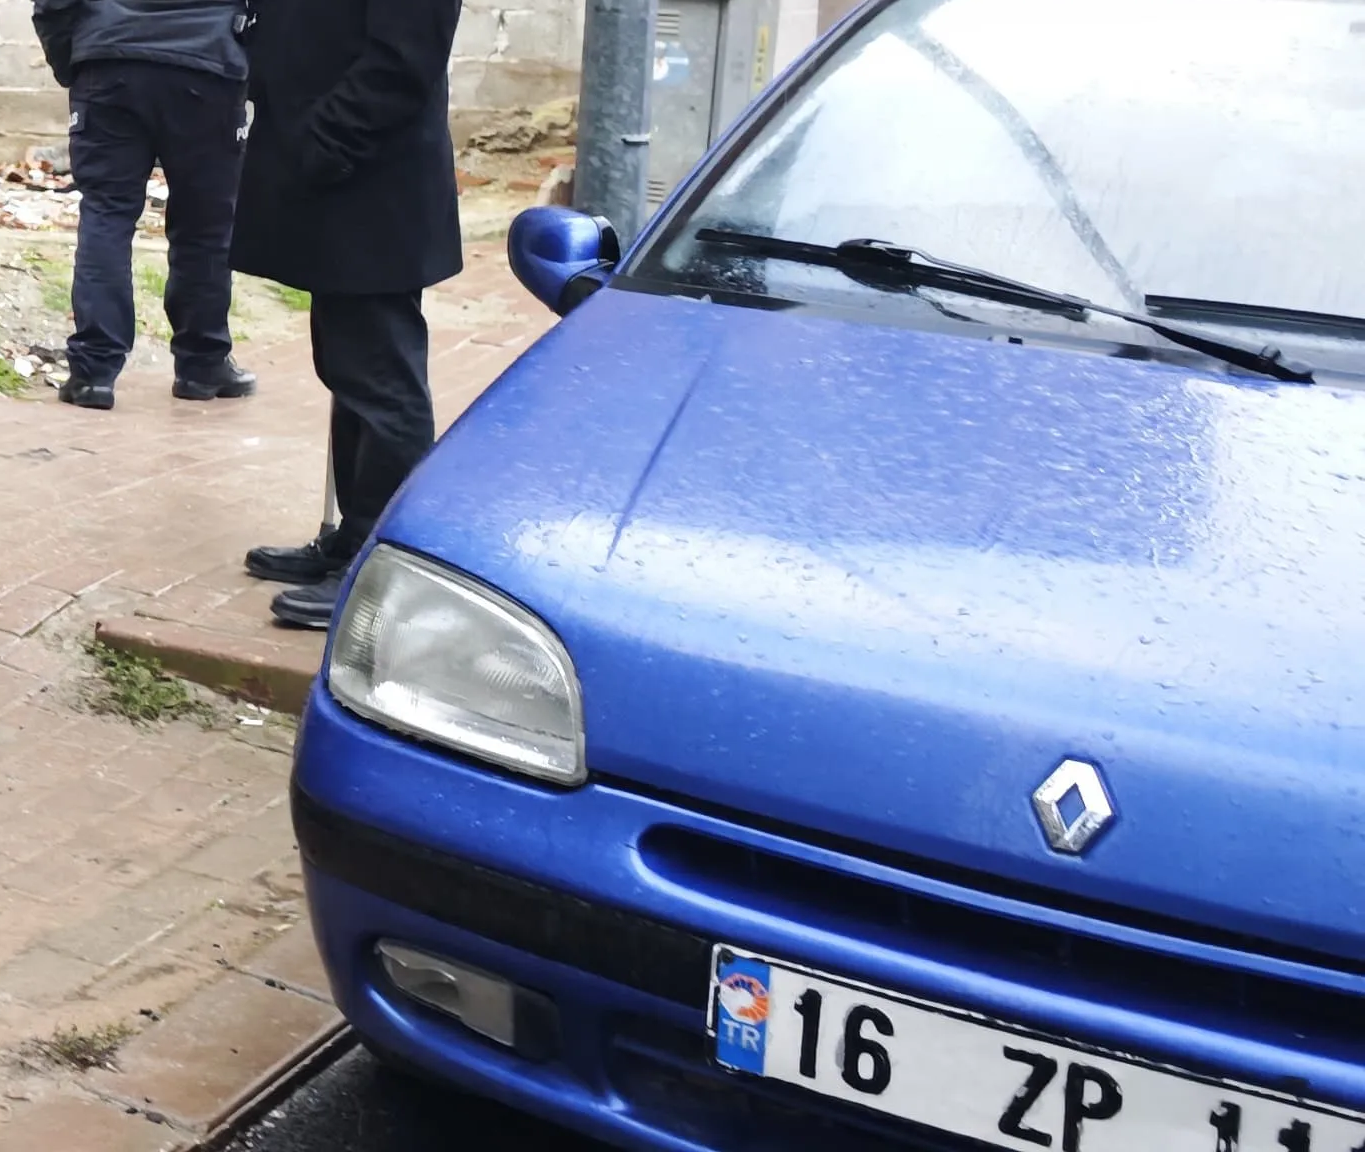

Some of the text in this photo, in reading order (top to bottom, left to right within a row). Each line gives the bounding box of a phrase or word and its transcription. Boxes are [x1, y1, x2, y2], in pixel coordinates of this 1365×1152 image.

[722, 1017, 761, 1053] TR
[793, 988, 895, 1096] 16
[997, 1045, 1124, 1152] ZP
